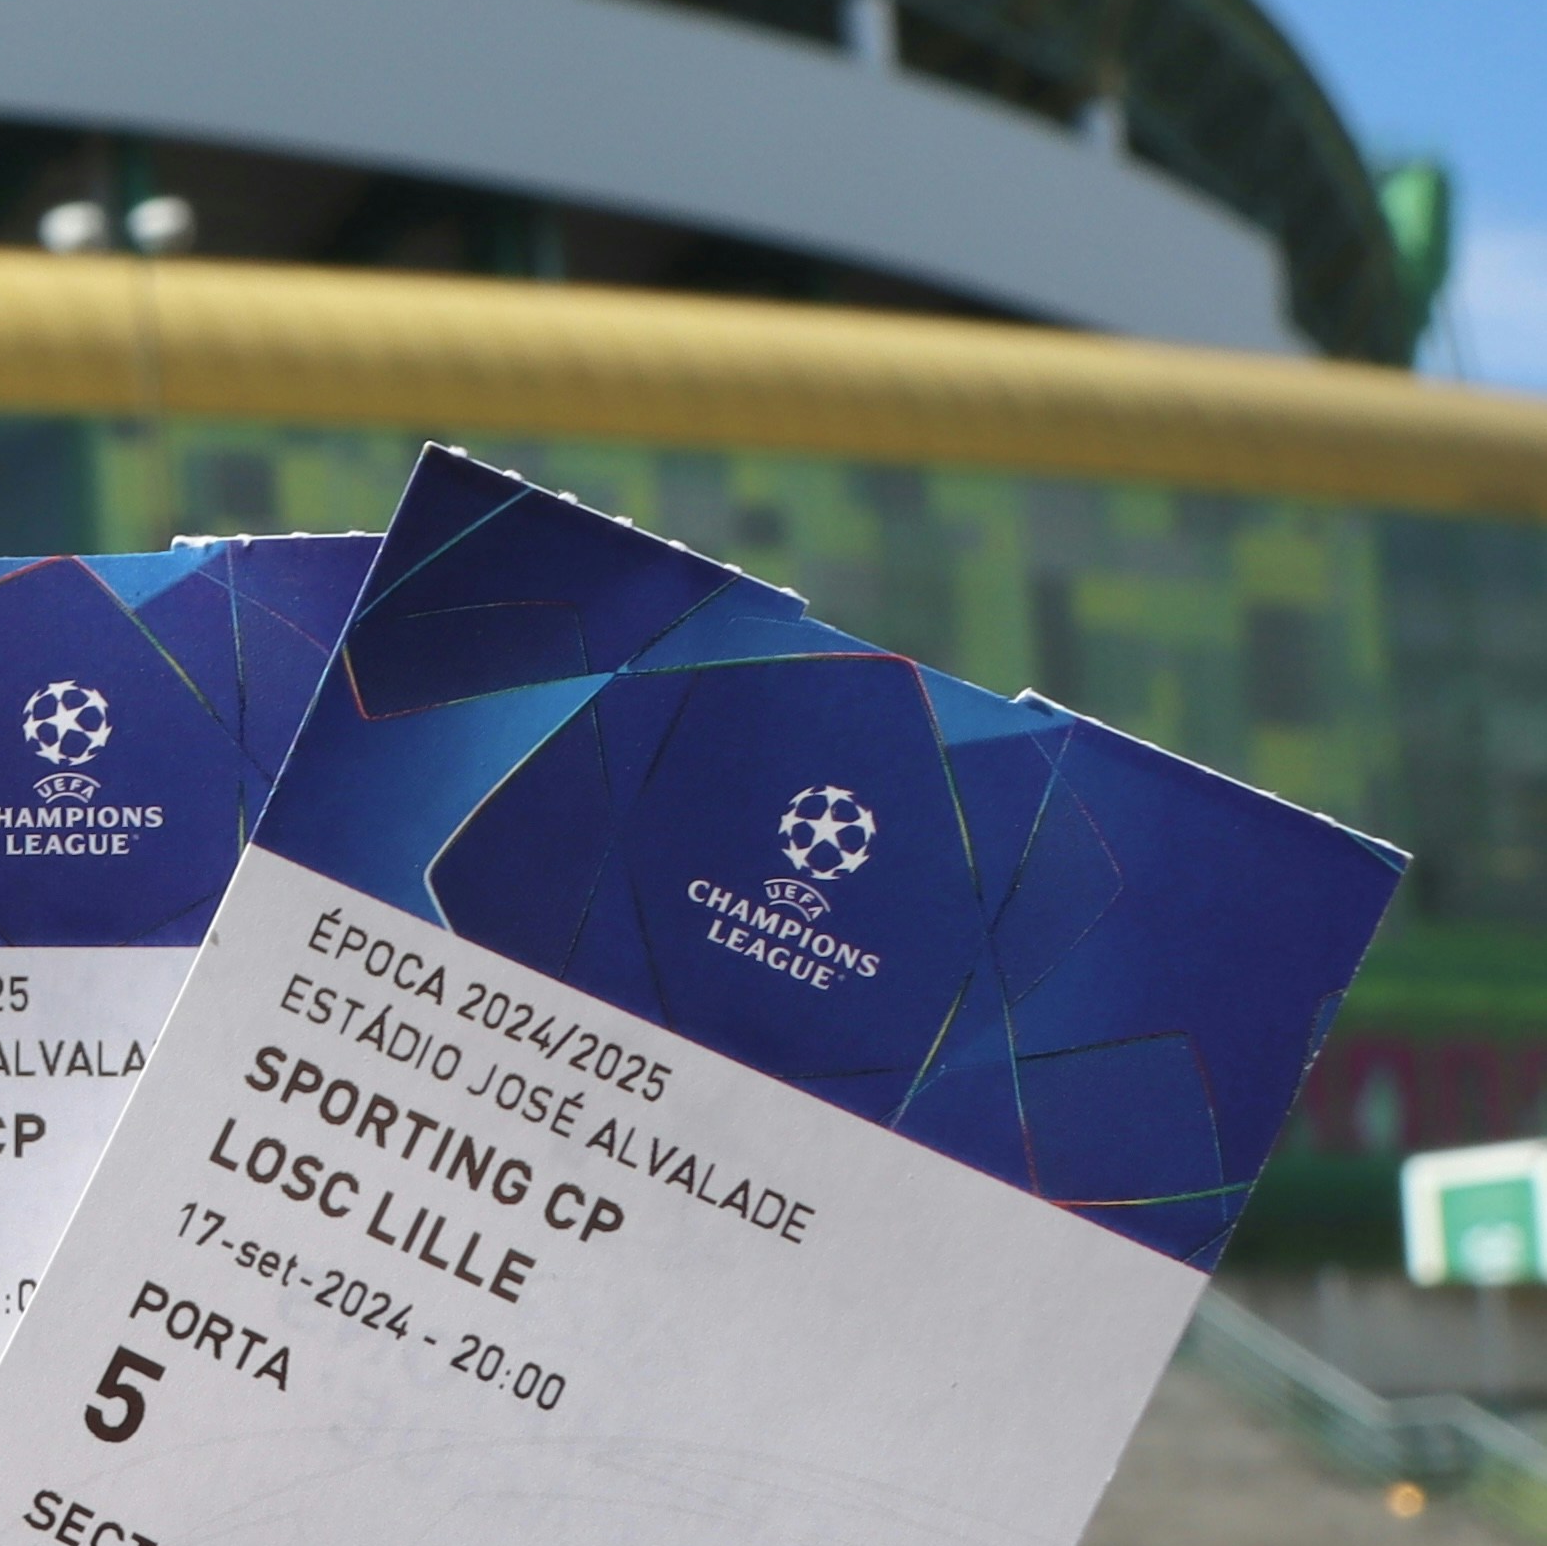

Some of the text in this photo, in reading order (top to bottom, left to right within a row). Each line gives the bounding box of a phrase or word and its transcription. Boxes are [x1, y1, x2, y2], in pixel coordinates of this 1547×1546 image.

[37, 779, 96, 800] UEFA
[5, 833, 130, 855] LEAGUE
[687, 879, 880, 978] CHAMPIONS
[706, 919, 835, 990] LEAGUE
[765, 883, 824, 920] UEFA
[307, 907, 673, 1103] ÉPOCA 2024/2025
[244, 1045, 625, 1243] SPORTING CP
[280, 973, 816, 1245] ESTÁDIO JOSÉ ALVALADE
[208, 1117, 537, 1304] LOSC LILLE
[128, 1280, 290, 1392] PORTA
[178, 1202, 413, 1341] 17-set-2024
[449, 1334, 566, 1411] 20:00
[83, 1344, 167, 1444] 5
